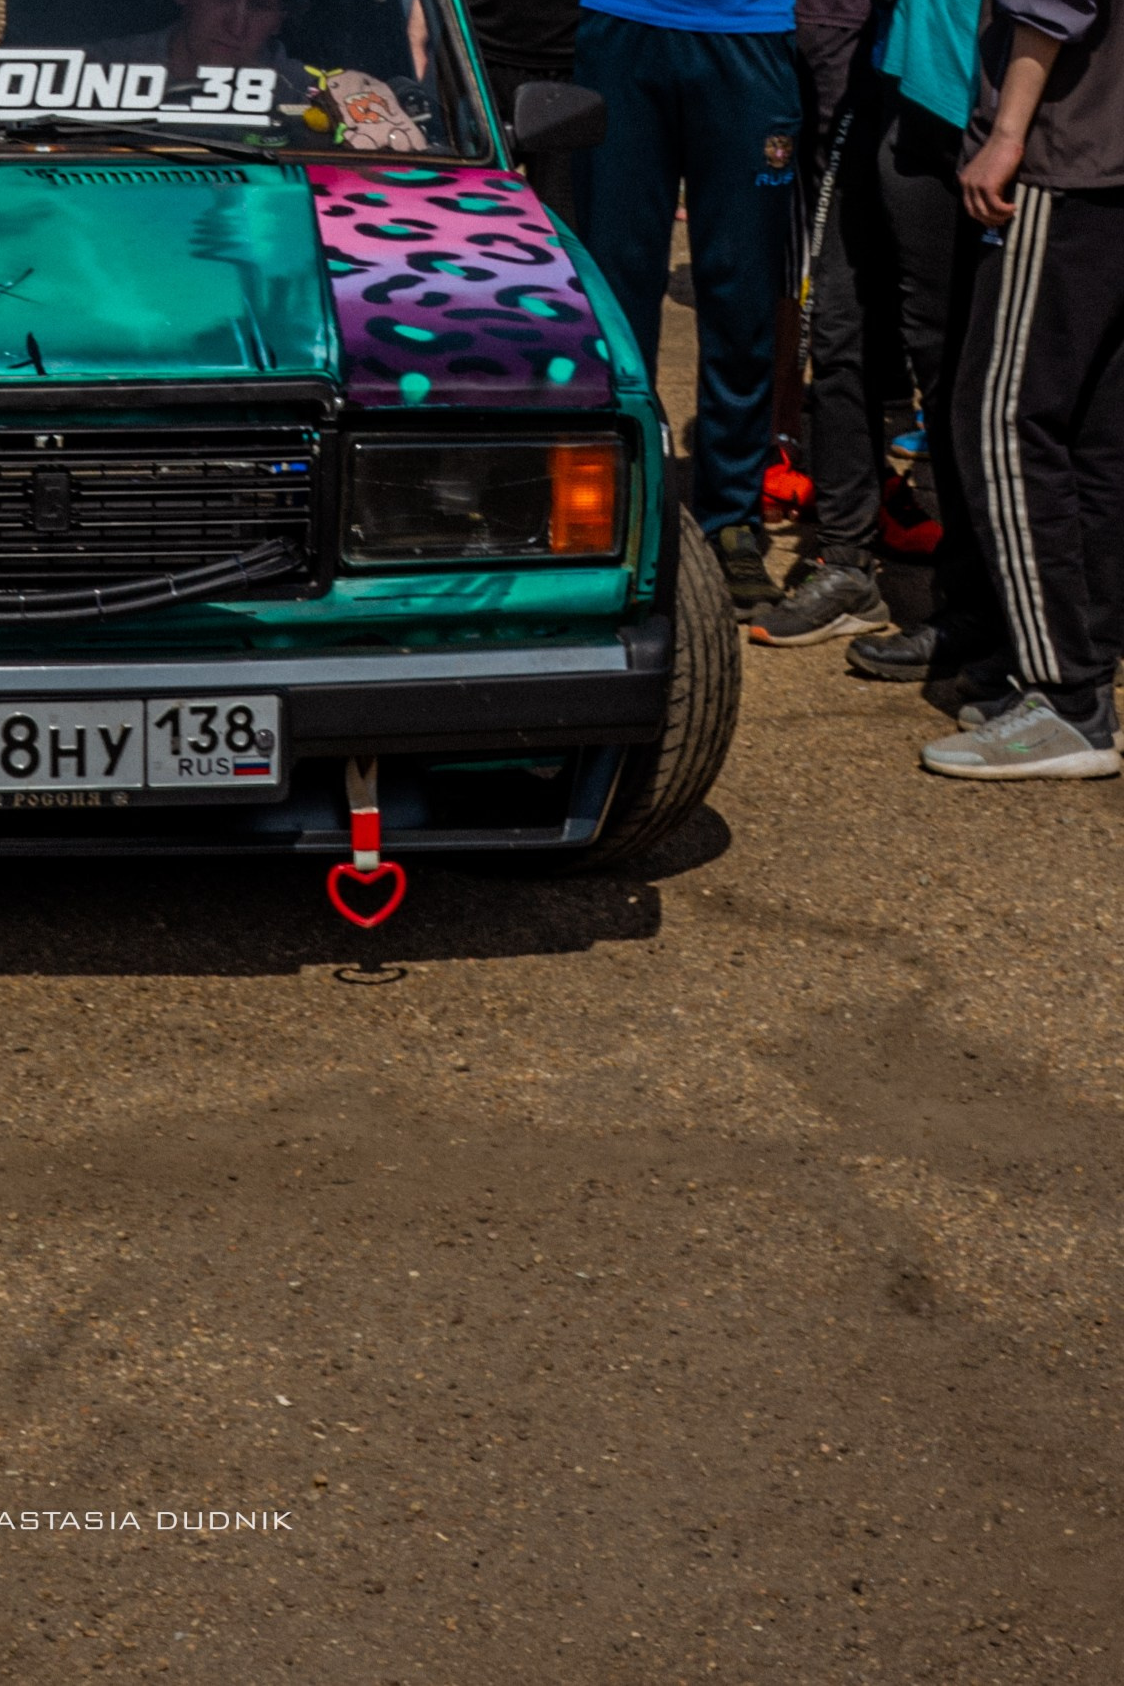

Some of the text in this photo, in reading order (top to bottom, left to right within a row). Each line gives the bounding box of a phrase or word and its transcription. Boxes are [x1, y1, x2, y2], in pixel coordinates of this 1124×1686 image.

[155, 705, 256, 756] 138
[179, 757, 230, 777] RUS
[13, 791, 102, 808] РОССИЯ
